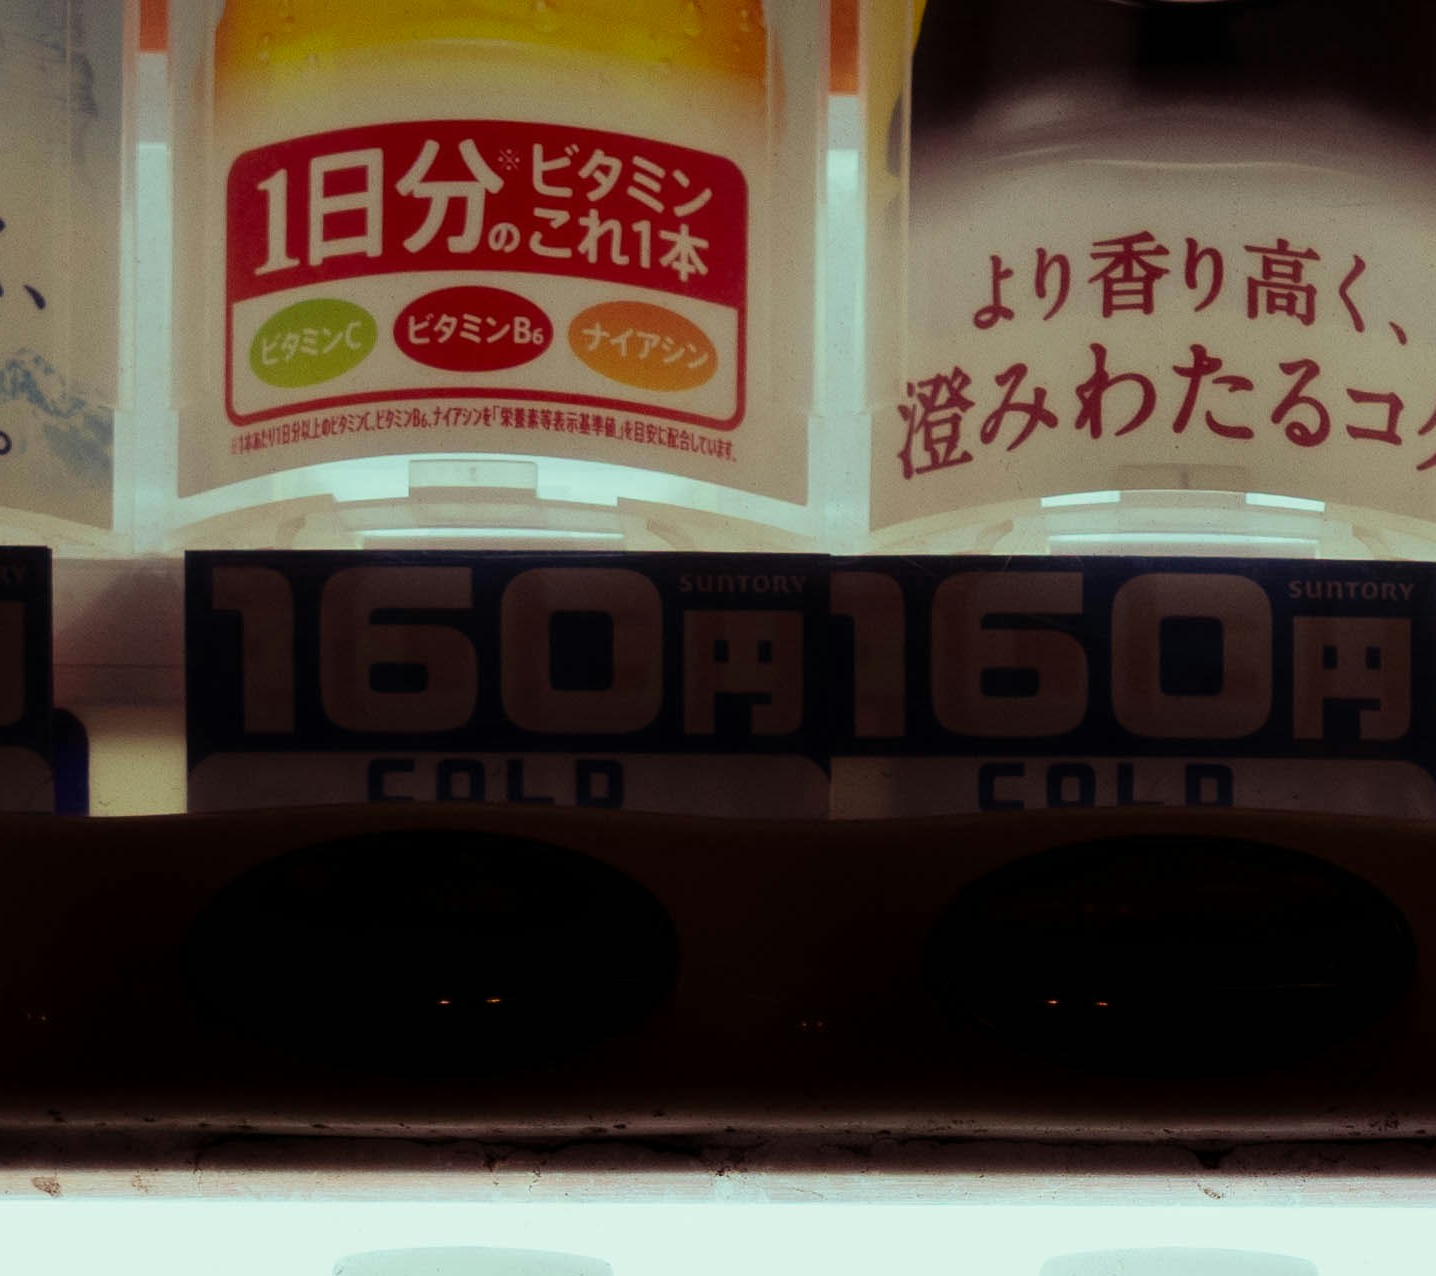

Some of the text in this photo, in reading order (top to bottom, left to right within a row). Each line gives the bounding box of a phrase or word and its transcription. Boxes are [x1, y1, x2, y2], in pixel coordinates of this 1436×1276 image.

[973, 231, 1408, 345] より香り高く、
[259, 318, 362, 366] ビタミンC
[582, 323, 709, 370] ナイアシン
[368, 760, 625, 806] COLD
[977, 762, 1235, 811] COLD
